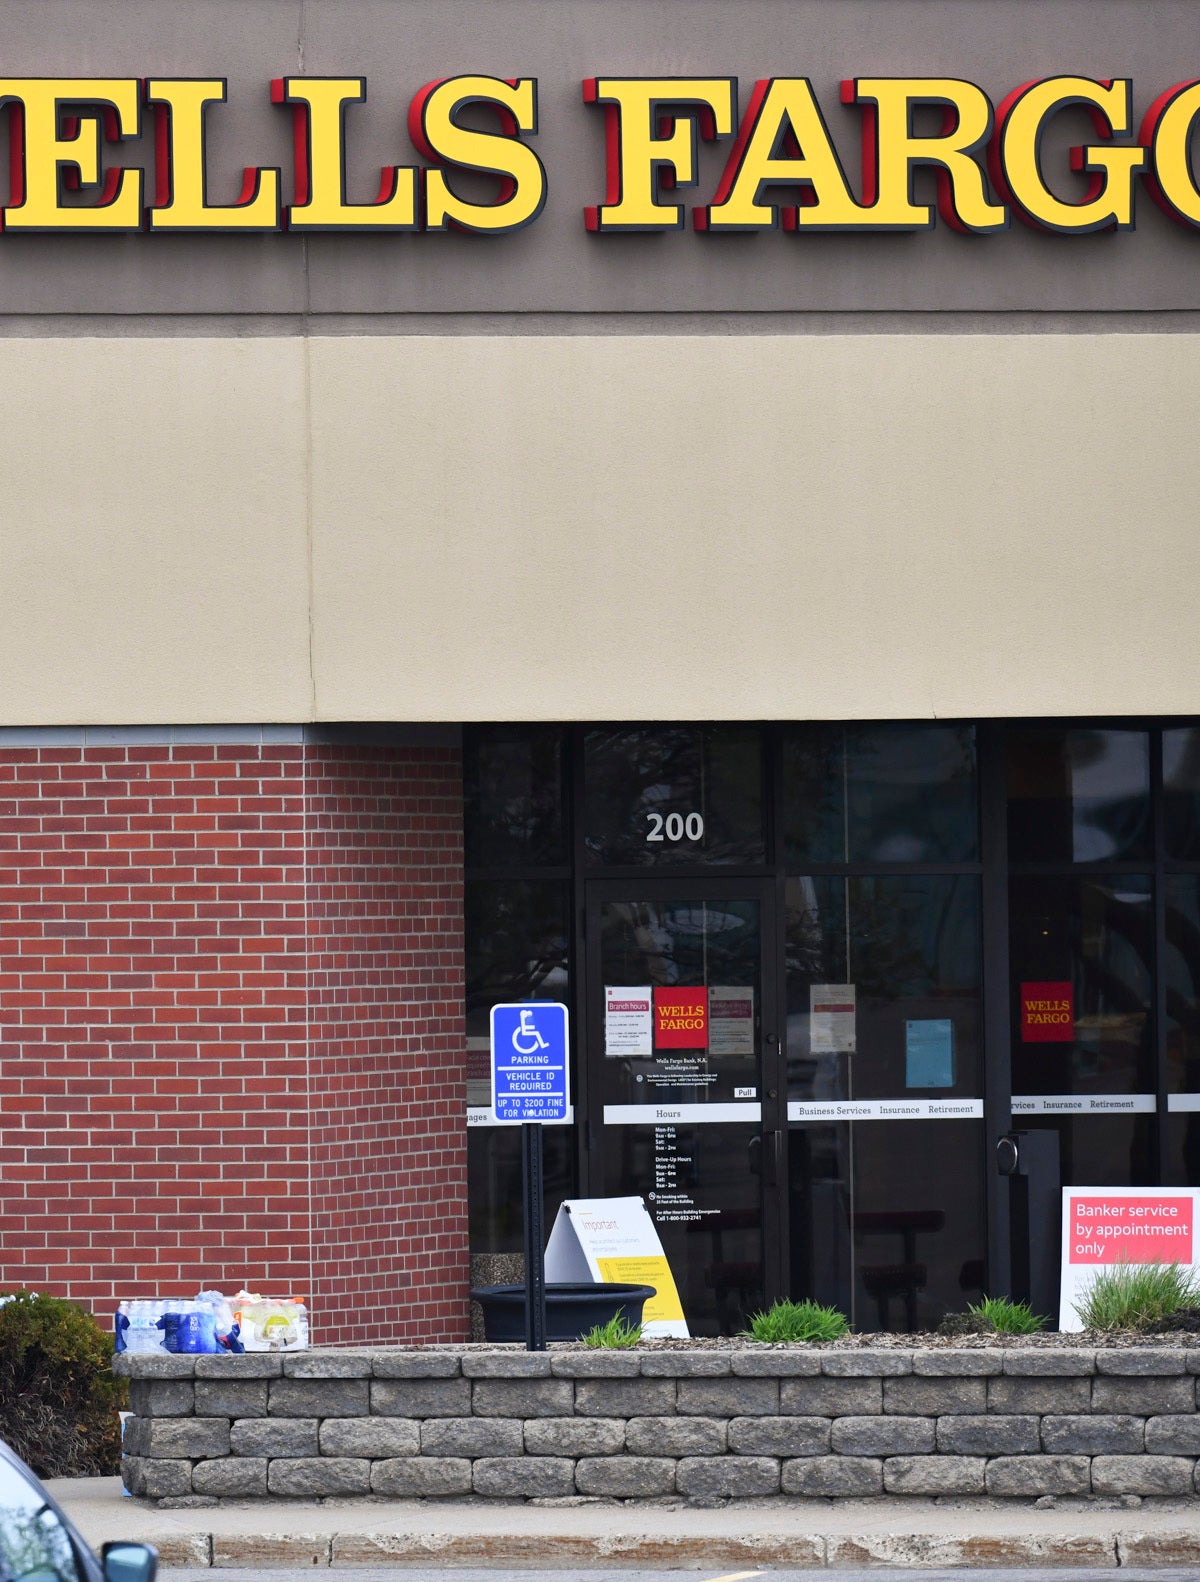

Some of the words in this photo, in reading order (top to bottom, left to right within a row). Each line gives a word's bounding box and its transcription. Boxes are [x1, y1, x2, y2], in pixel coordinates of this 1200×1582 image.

[646, 812, 704, 842] 200
[658, 1005, 705, 1017] WELLS
[1025, 1000, 1070, 1011] WELLS
[659, 1018, 705, 1030] FARGO
[1026, 1013, 1070, 1024] FARGO
[511, 1056, 549, 1064] PARKING
[506, 1072, 542, 1080] VEHICLE
[546, 1072, 555, 1080] ID
[510, 1082, 552, 1090] REQUIRED
[498, 1100, 508, 1108] UP
[512, 1100, 520, 1108] TO
[524, 1098, 544, 1108] $200
[548, 1098, 564, 1107] FINE
[522, 1108, 559, 1117] VILATION
[656, 1110, 681, 1118] Hours
[1076, 1204, 1125, 1217] Banker
[1128, 1204, 1178, 1217] service
[1076, 1223, 1093, 1238] by
[1096, 1223, 1189, 1238] appointment
[1076, 1242, 1105, 1257] only
